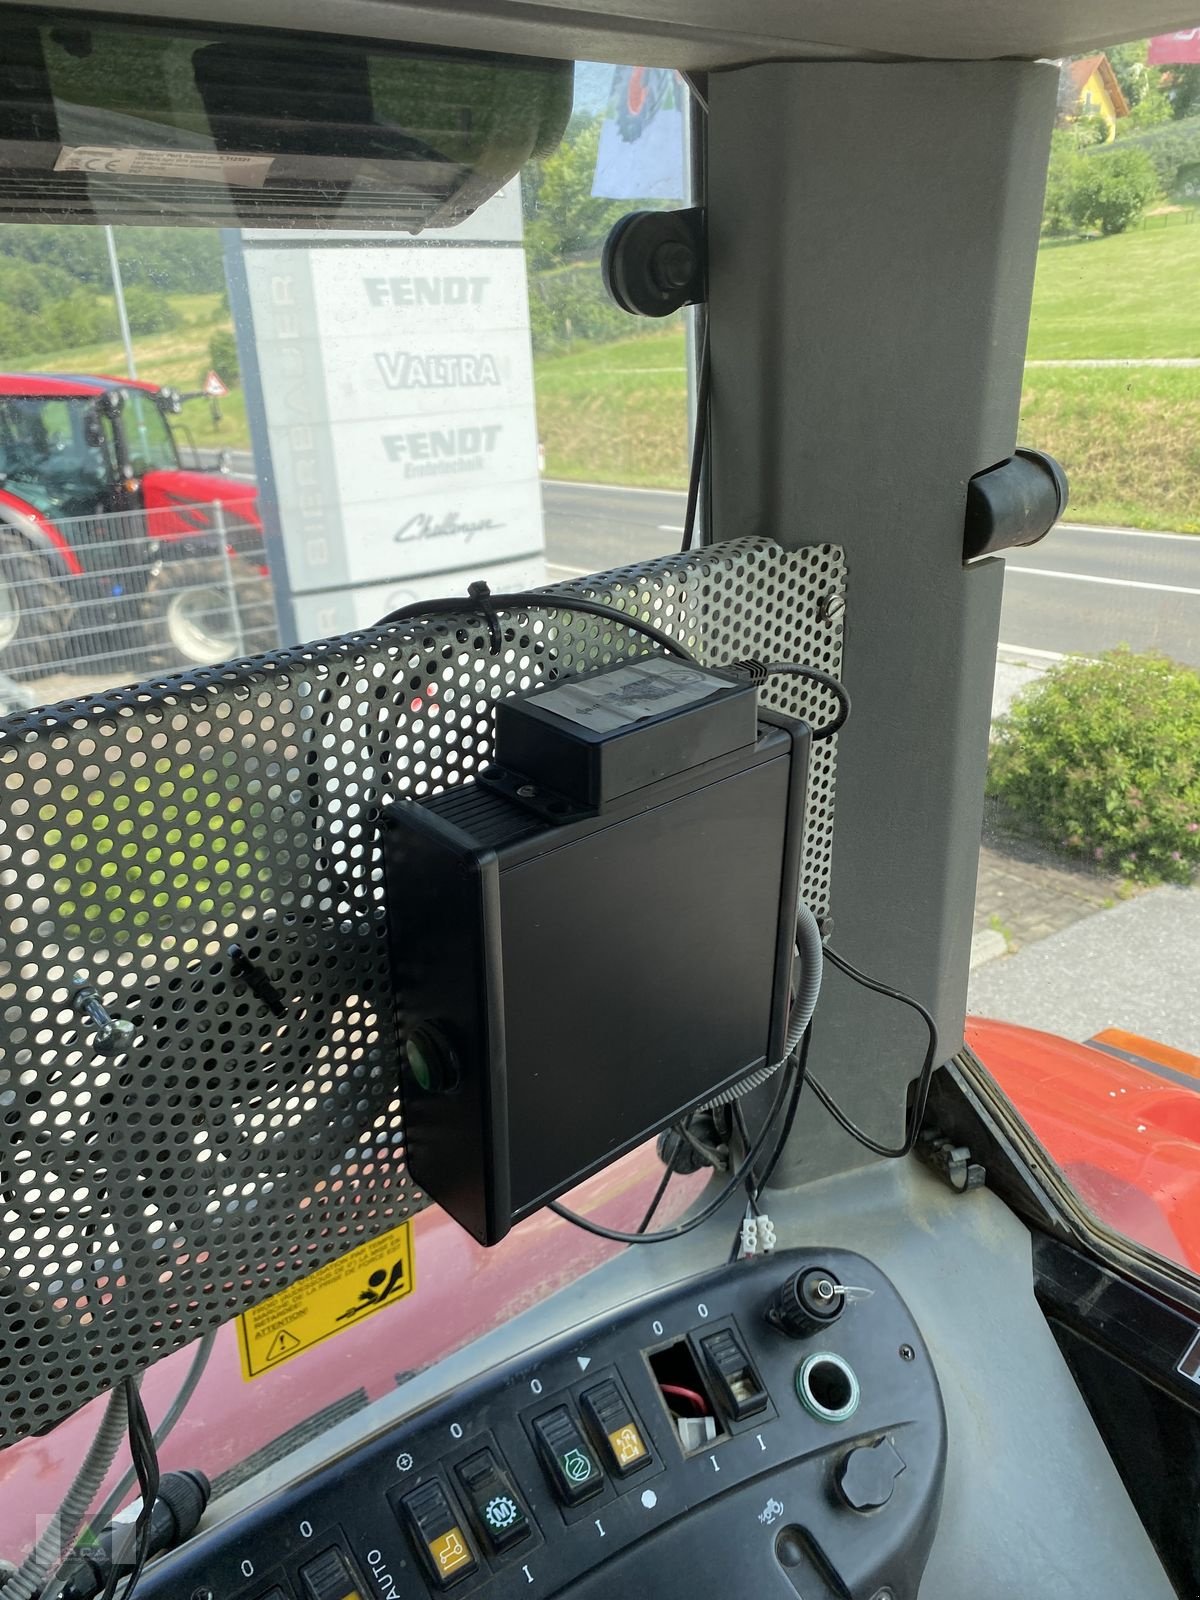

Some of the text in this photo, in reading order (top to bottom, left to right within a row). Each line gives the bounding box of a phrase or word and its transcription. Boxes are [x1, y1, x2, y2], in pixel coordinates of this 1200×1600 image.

[363, 277, 490, 306] FENDT
[374, 352, 501, 390] VALTRA
[382, 424, 502, 462] FENDT
[393, 511, 507, 544] Challenger
[695, 1303, 707, 1318] 0
[253, 1305, 307, 1340] ATTENTION!
[652, 1320, 664, 1336] 0
[530, 1378, 542, 1394] 0
[450, 1423, 463, 1439] 0
[300, 1521, 312, 1537] 0
[241, 1560, 254, 1577] 0
[367, 1549, 401, 1600] AUTO
